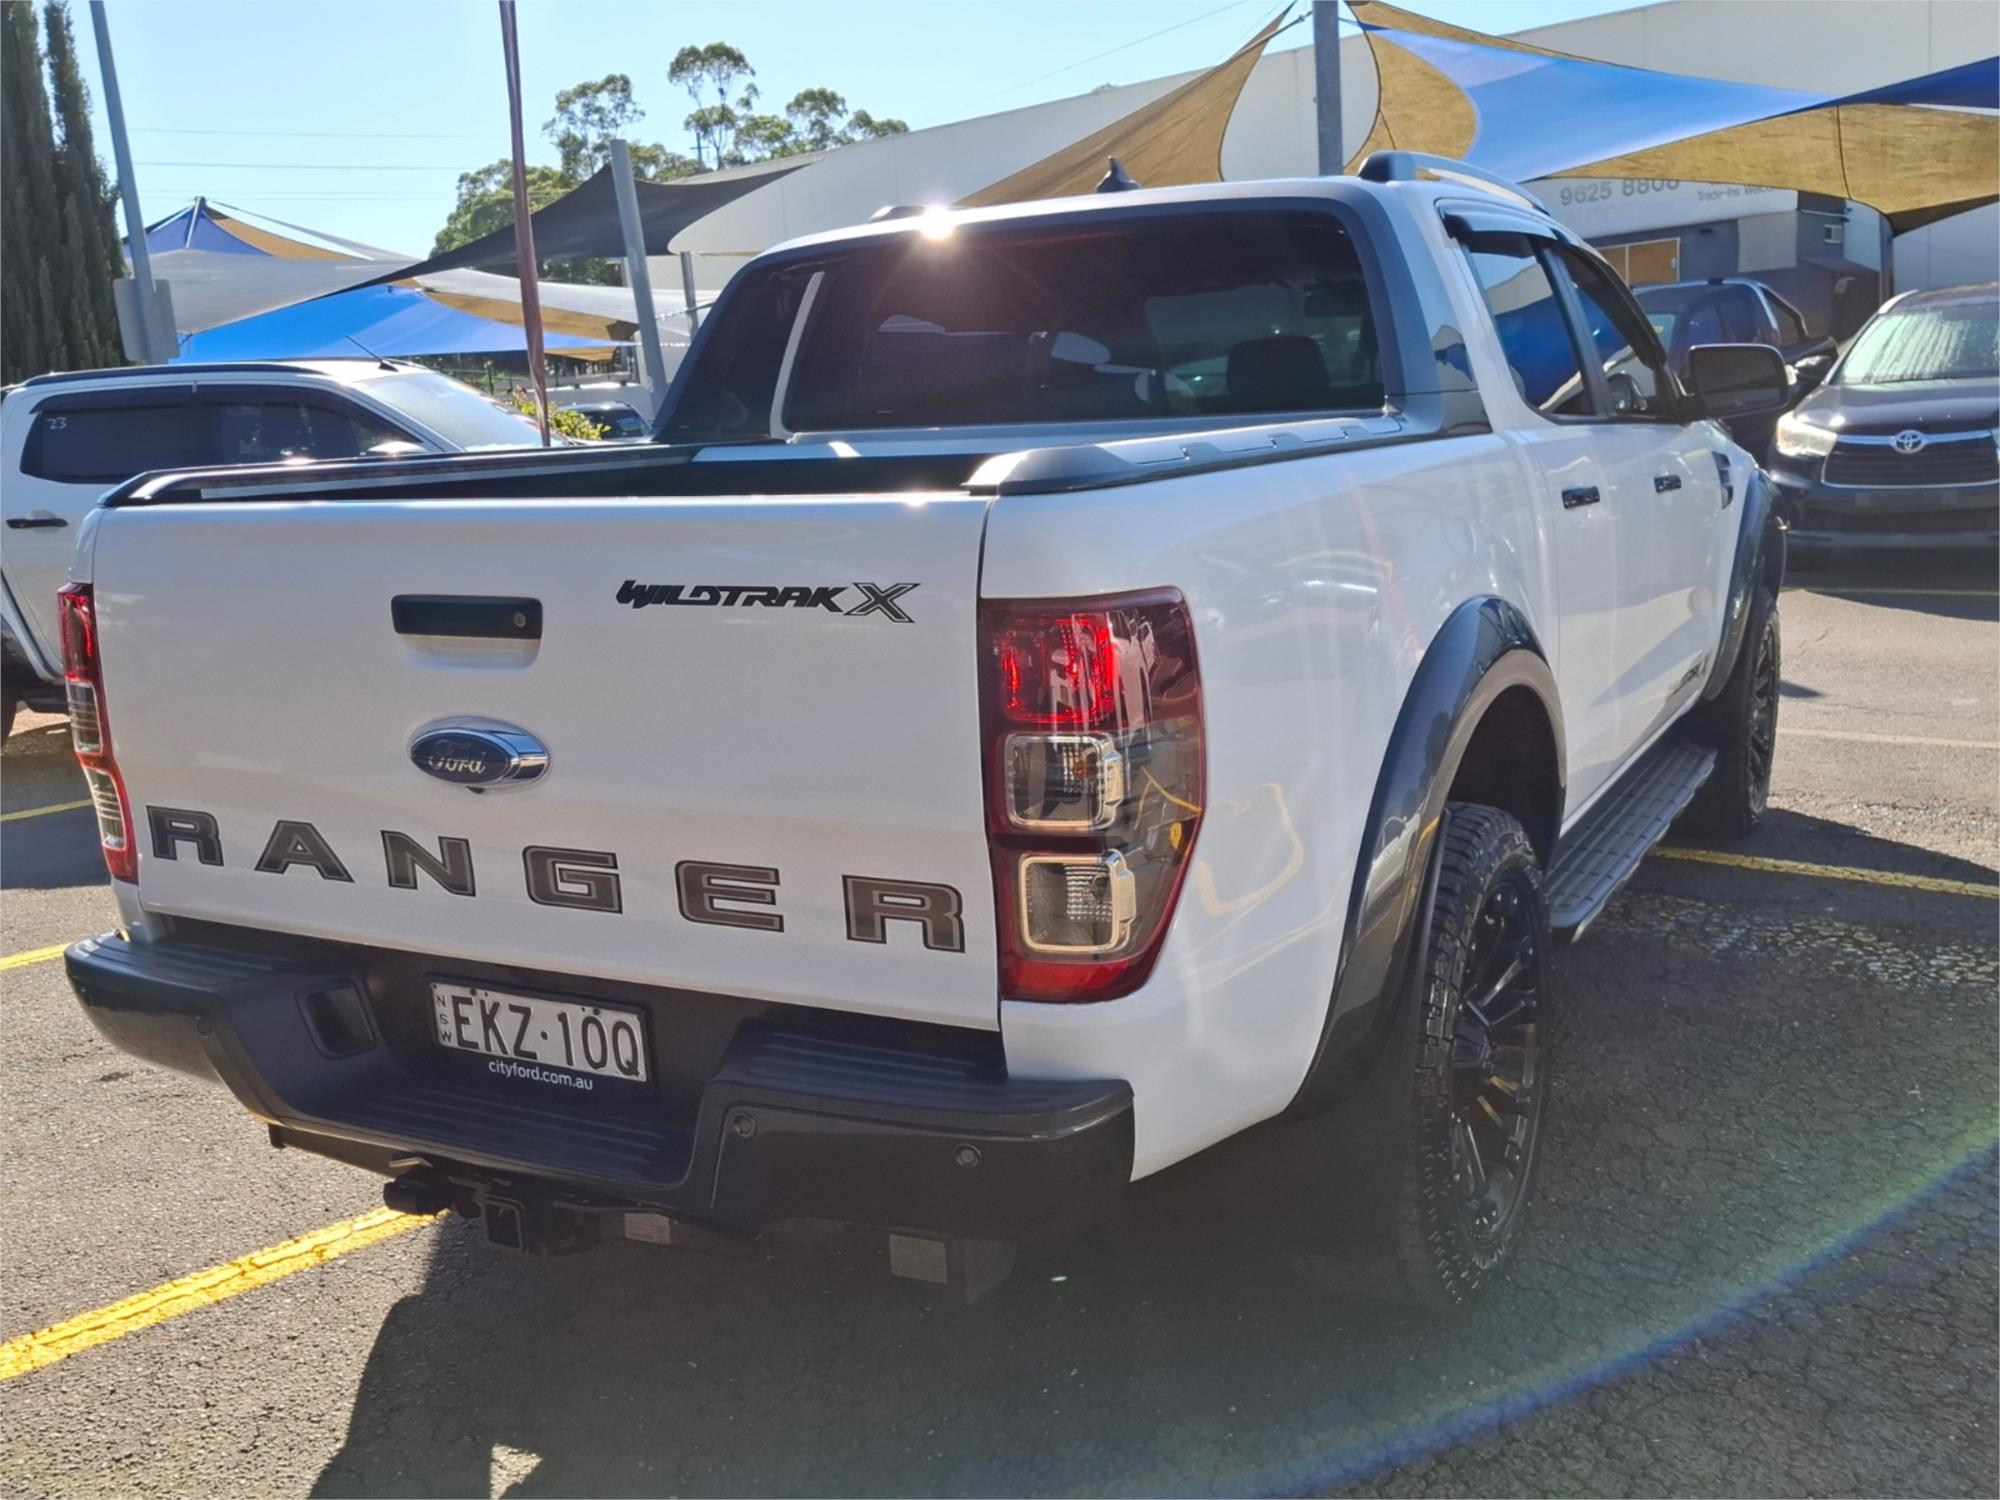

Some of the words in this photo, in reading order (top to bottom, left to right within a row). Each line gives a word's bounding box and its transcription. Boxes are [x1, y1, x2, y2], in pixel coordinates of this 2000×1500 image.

[1560, 181, 1612, 206] 9625
[46, 416, 67, 430] 23
[145, 804, 965, 953] RANGER
[488, 1059, 594, 1091] cityford.com.au
